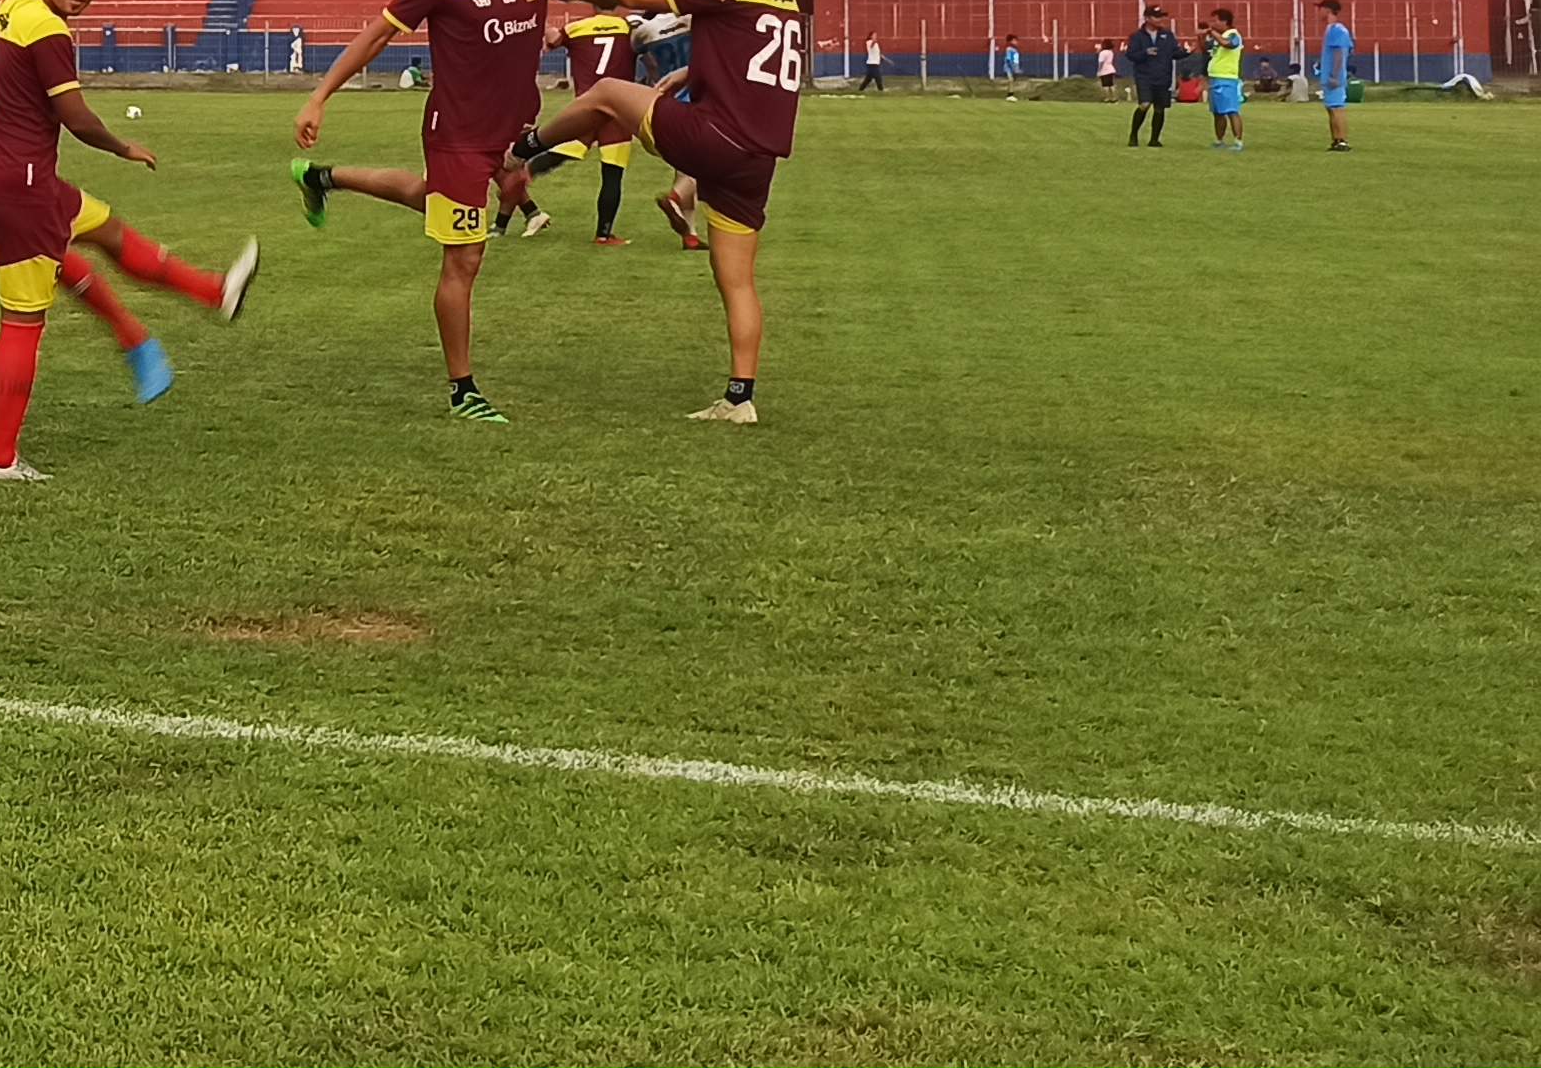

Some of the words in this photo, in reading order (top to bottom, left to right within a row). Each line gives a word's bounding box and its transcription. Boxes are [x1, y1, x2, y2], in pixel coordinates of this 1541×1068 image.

[593, 37, 615, 75] 7
[746, 13, 802, 92] 26
[452, 208, 480, 231] 29
